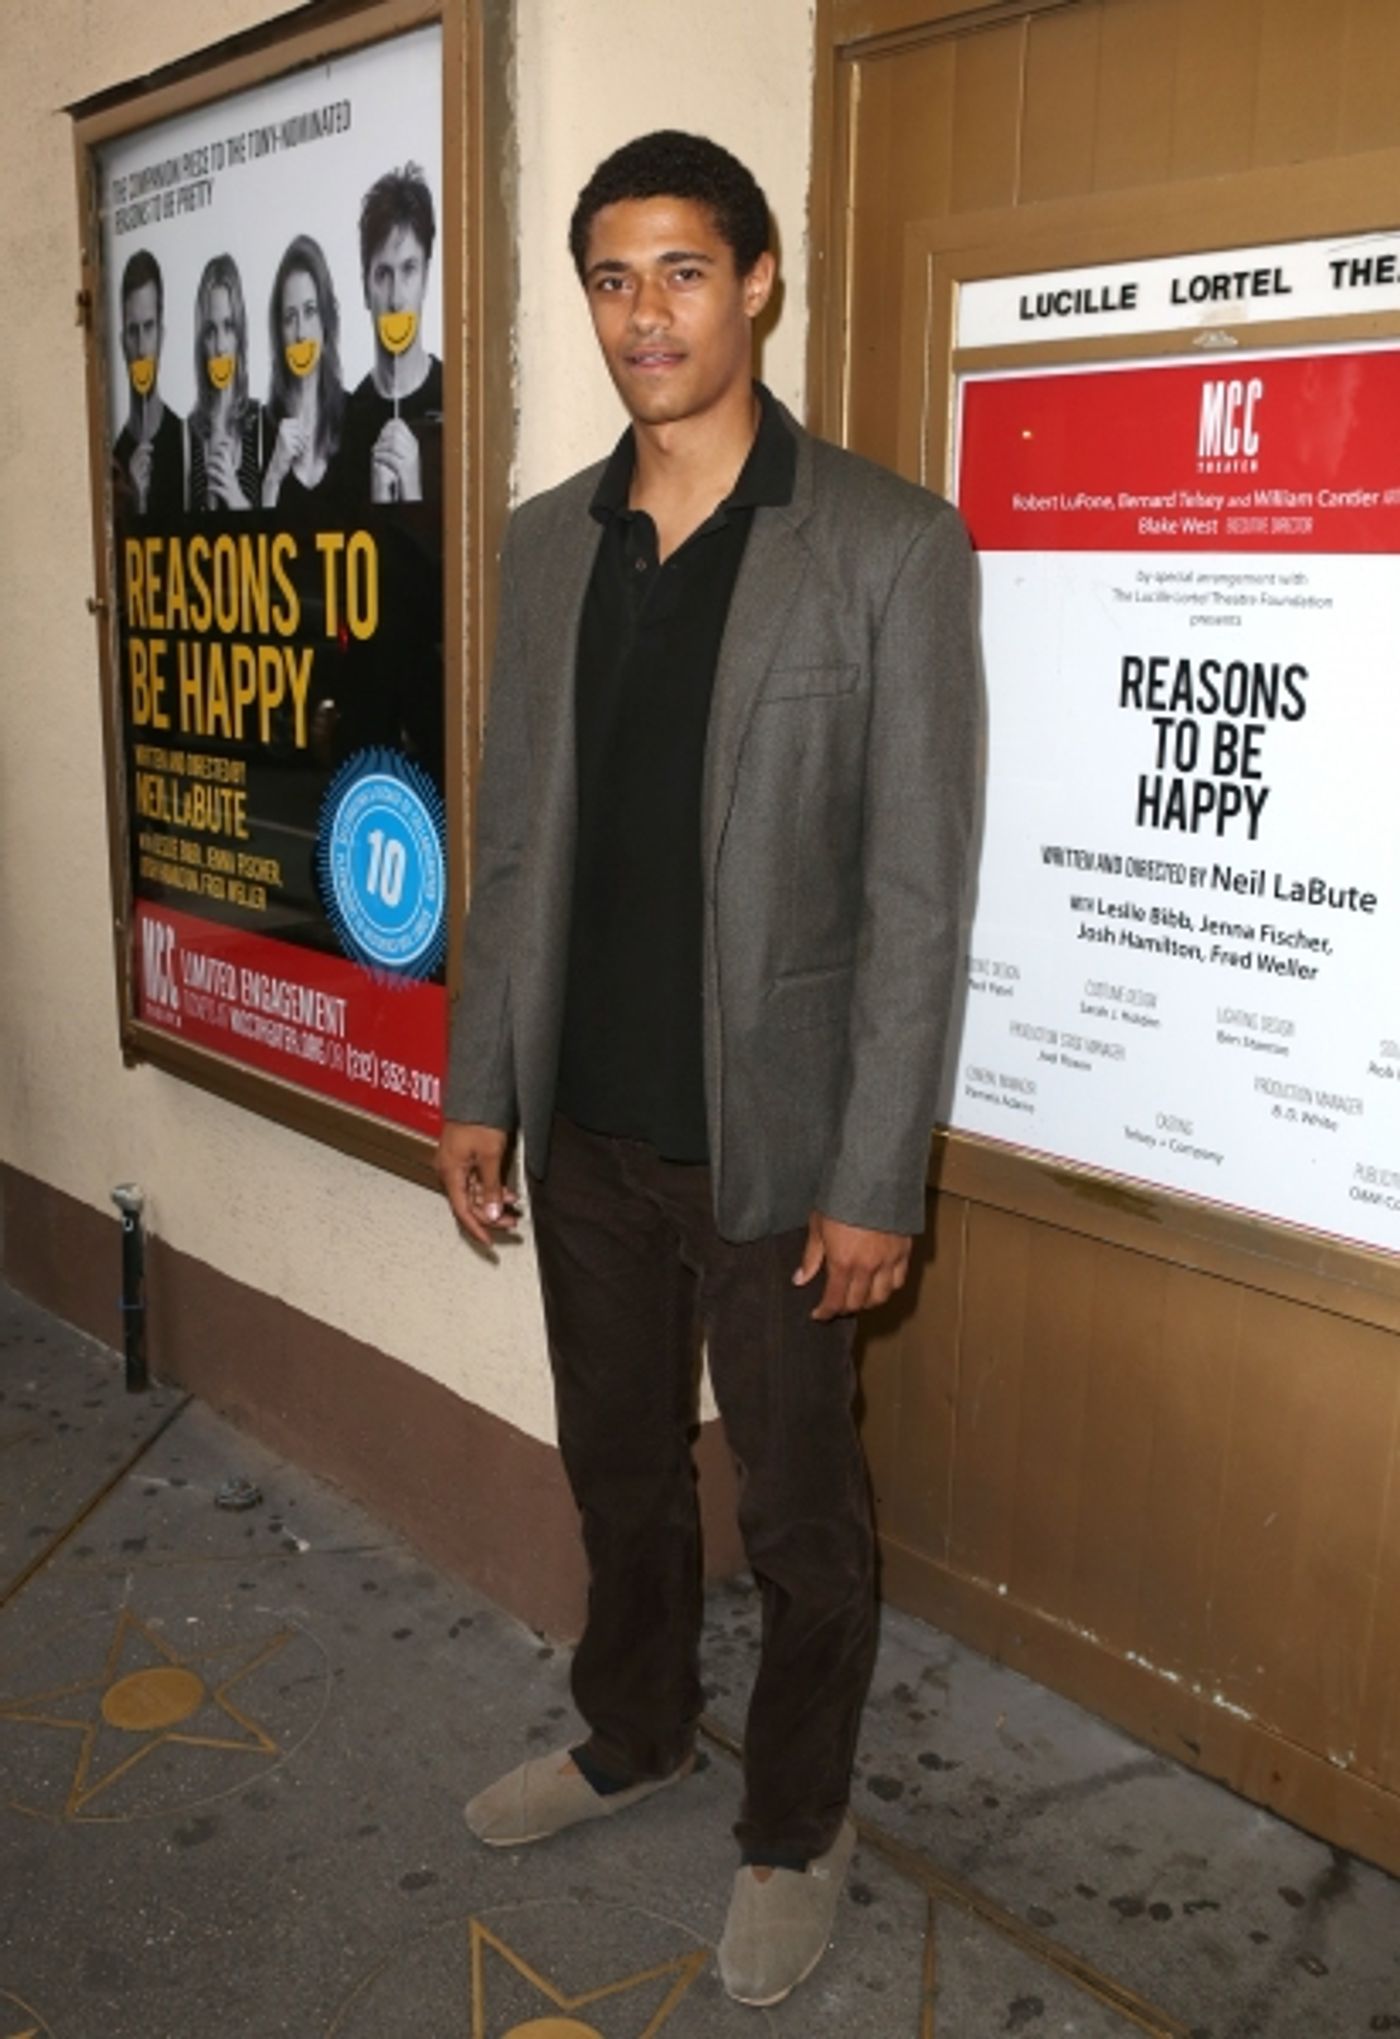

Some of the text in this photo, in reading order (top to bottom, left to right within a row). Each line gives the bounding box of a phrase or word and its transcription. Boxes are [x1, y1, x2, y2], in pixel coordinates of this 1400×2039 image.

[1020, 254, 1400, 321] LUCILLE LORTEL THE
[1198, 378, 1263, 457] MCC
[1012, 493, 1057, 510] Robert
[1118, 491, 1176, 509] Bernard
[1227, 491, 1251, 507] and
[1254, 488, 1313, 508] William
[1138, 516, 1178, 535] Blake
[1182, 516, 1218, 535] West
[125, 529, 378, 640] REASONS TO
[128, 637, 314, 750] BE HAPPY
[1119, 655, 1309, 722] REASONS
[1153, 716, 1266, 780] TO BE
[1136, 774, 1270, 841] HAPPY
[367, 829, 406, 908] 10
[1041, 845, 1377, 913] WRITTEN AND DIRECTED BY Neil LaBute
[1077, 923, 1318, 980] Josh Hamilton, Fred Weller
[1097, 898, 1146, 922] Leslie
[1149, 907, 1194, 932] Bibb,
[1199, 915, 1255, 940] Jenna
[1260, 924, 1333, 955] Fischer,
[180, 949, 237, 1006] LIMITED
[240, 967, 348, 1038] ENGAGEMENT
